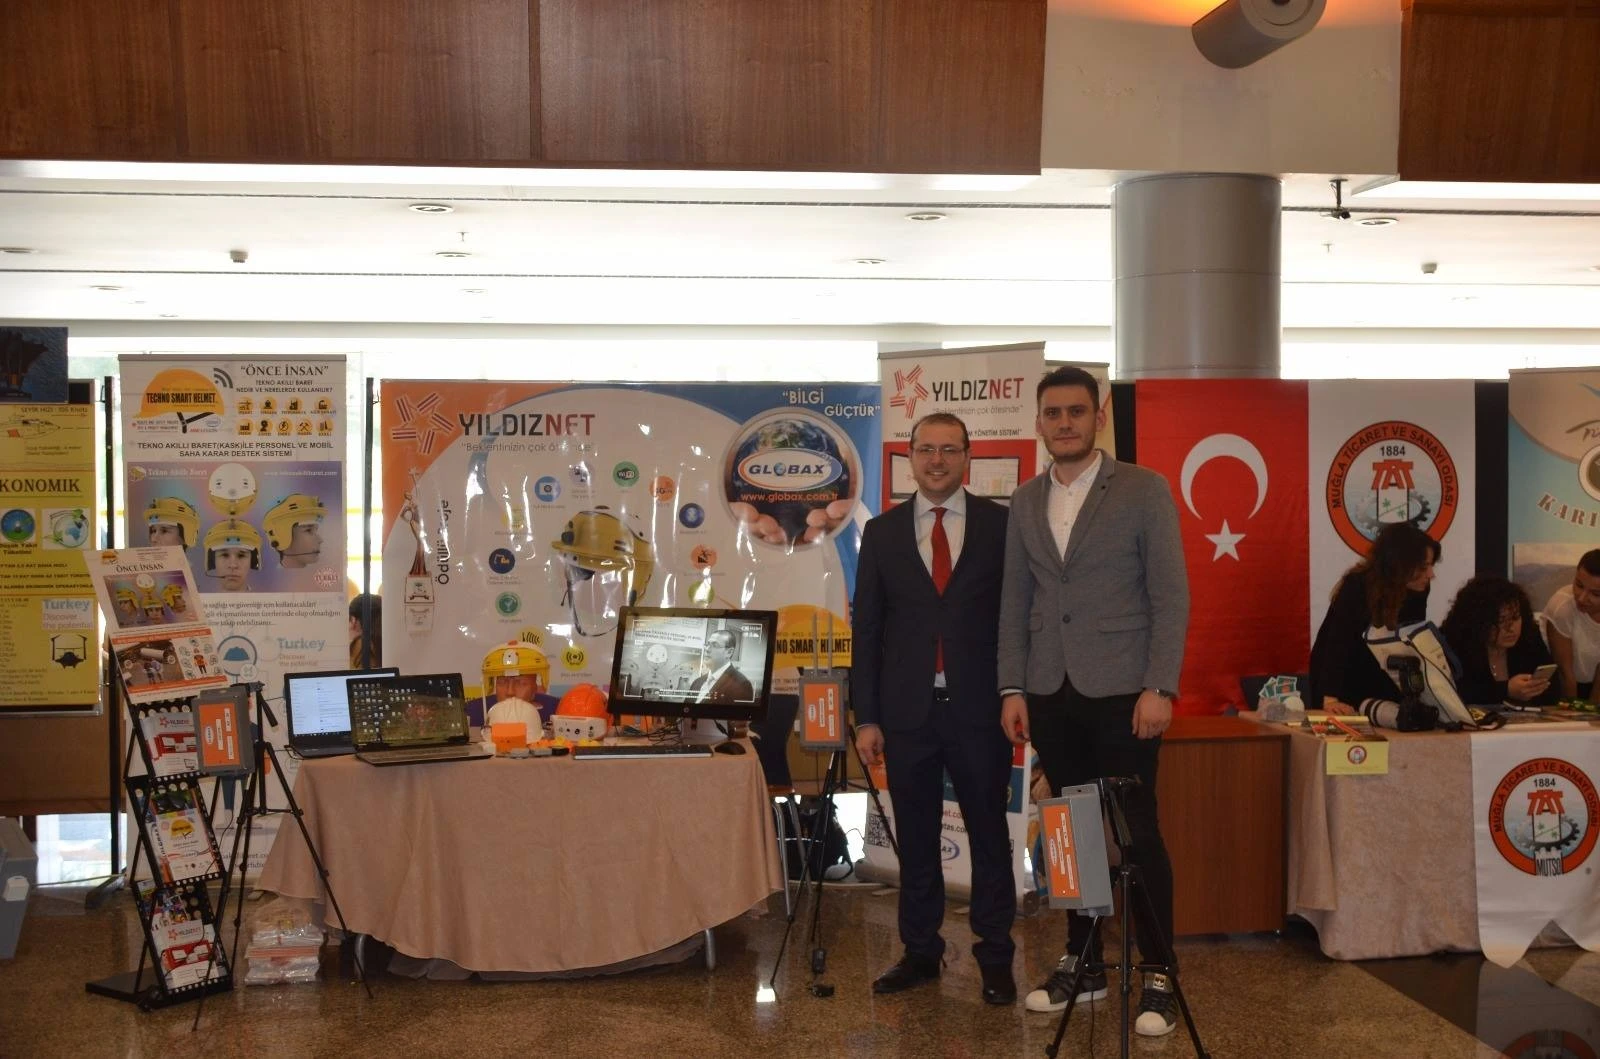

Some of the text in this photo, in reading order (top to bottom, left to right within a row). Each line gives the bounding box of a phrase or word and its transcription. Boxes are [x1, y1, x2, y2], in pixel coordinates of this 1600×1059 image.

[240, 364, 329, 377] “ÖNCE İNSAN”
[932, 377, 1025, 402] YILDIZNET
[146, 392, 216, 404] TECHNO SMART HELMET
[782, 388, 825, 405] “BİLGİ
[824, 405, 881, 419] GÜÇTÜR”
[458, 412, 597, 436] YILDIZNET
[1379, 445, 1406, 457] 1884
[748, 462, 825, 477] GLOBAX
[1391, 426, 1407, 438] VE
[1441, 464, 1455, 507] ODASI
[740, 492, 838, 504] www.globax.com.tr
[43, 599, 90, 612] Turkey
[1533, 778, 1556, 788] 1884
